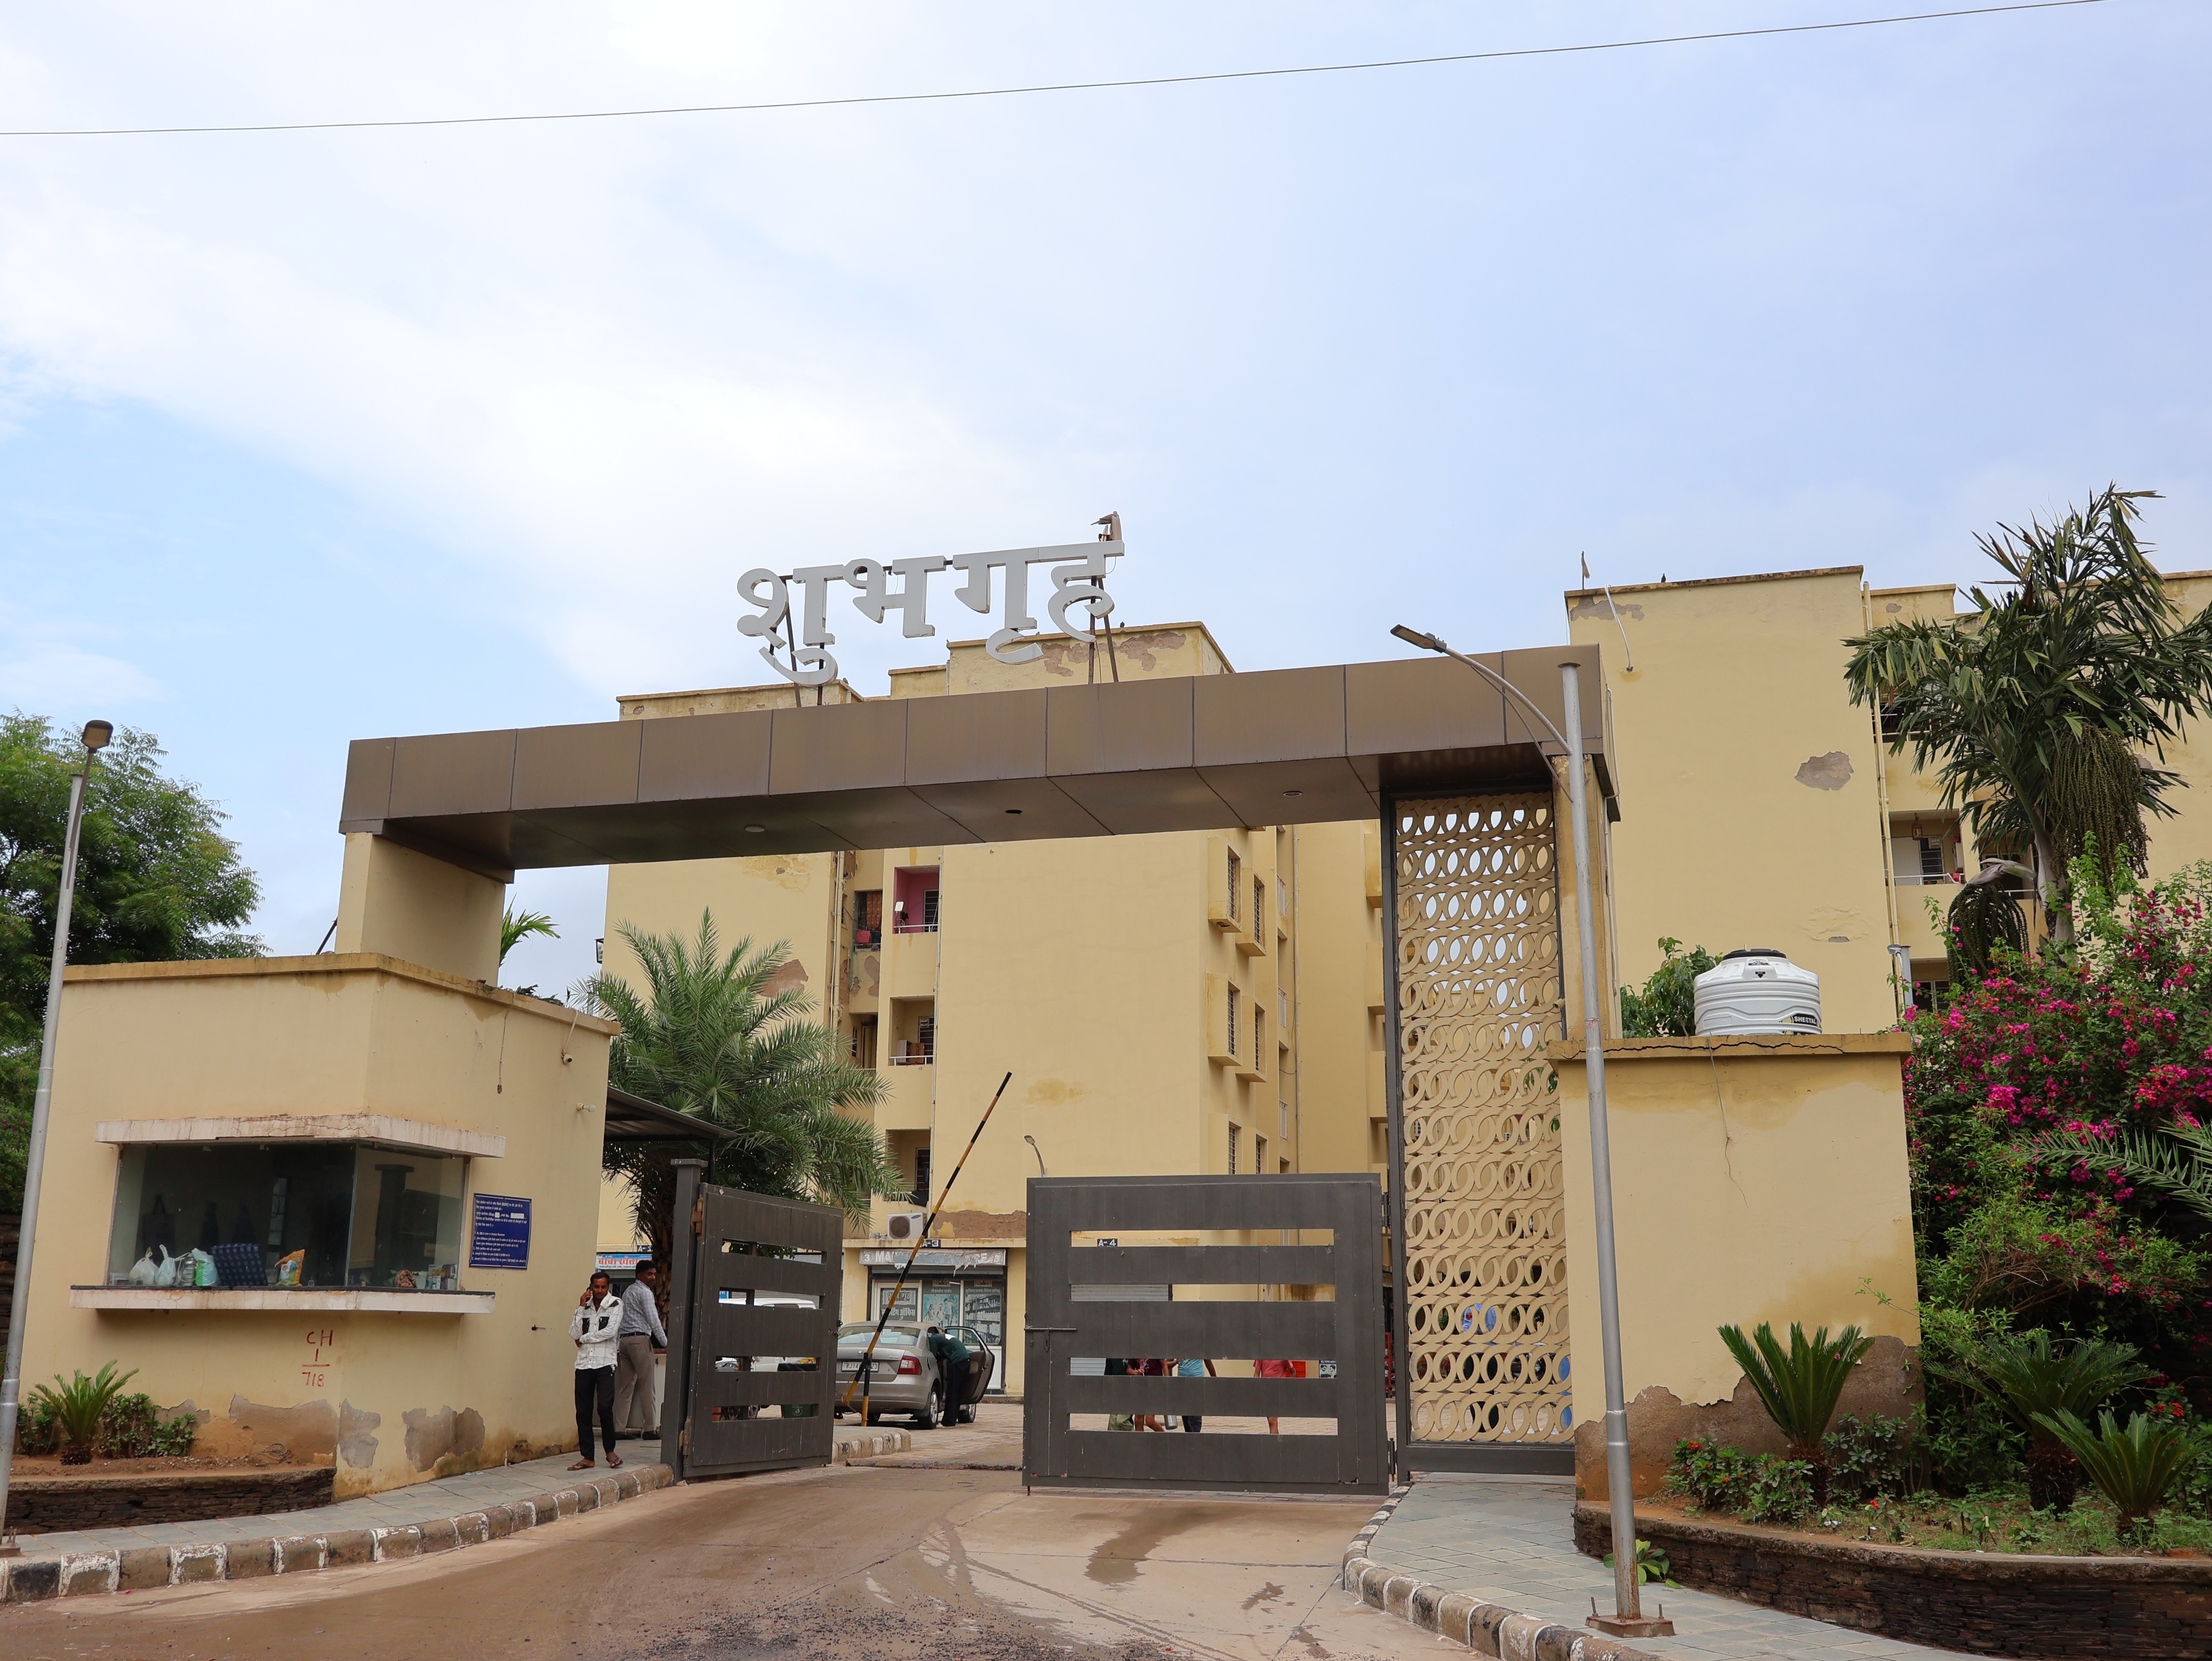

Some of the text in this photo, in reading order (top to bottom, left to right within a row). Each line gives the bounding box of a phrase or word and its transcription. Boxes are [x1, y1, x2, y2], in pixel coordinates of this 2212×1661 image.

[1794, 1016, 1817, 1024] SHEETAL
[307, 1330, 333, 1346] CH
[302, 1372, 324, 1387] 718
